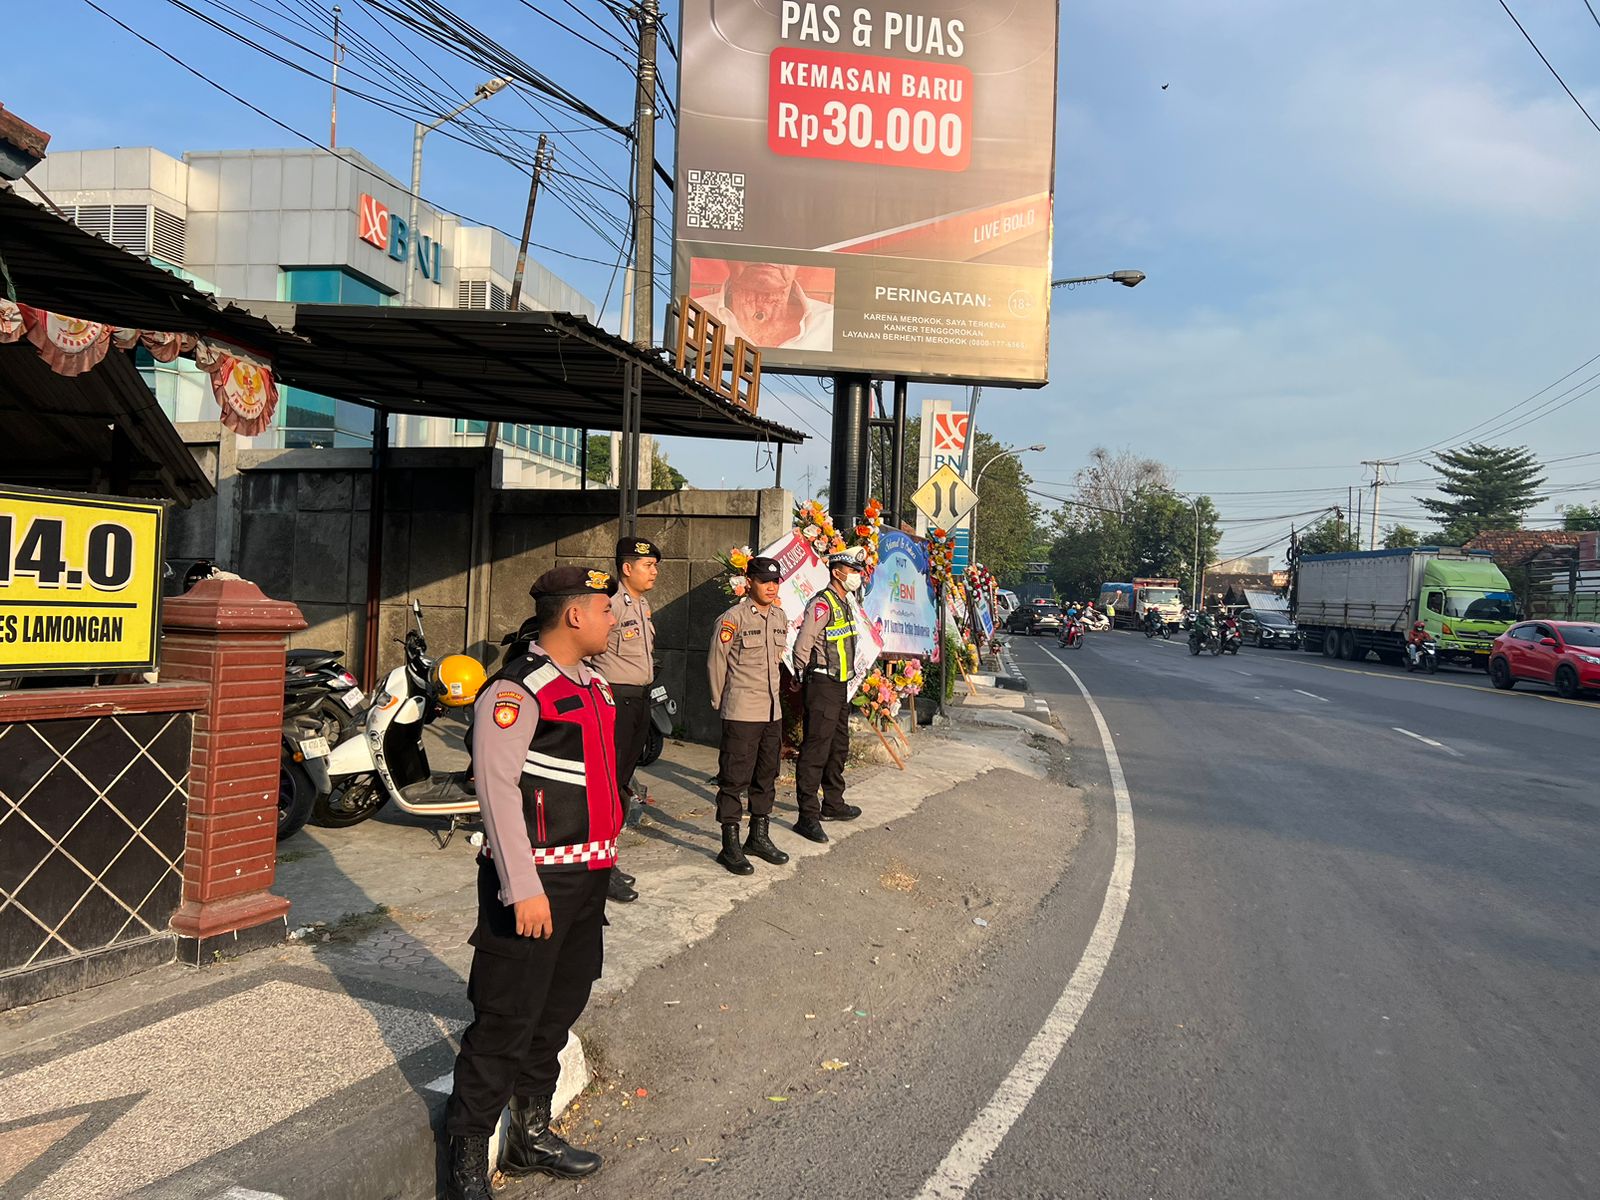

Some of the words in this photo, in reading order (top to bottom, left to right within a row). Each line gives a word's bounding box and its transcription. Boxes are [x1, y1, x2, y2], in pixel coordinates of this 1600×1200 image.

[781, 0, 841, 44] PAS
[852, 8, 873, 47] &
[884, 11, 965, 58] PUAS
[780, 61, 891, 95] KEMASAN
[901, 74, 963, 102] BARU
[778, 101, 962, 157] Rp30.000
[973, 220, 1001, 244] LIVE
[1003, 208, 1035, 233] BOLD
[388, 213, 442, 285] BNI
[875, 286, 992, 307] PERINGATAN:
[863, 313, 898, 322] KARENA
[945, 318, 967, 327] SAYA
[968, 319, 1006, 330] TERKENA
[883, 324, 919, 333] KANKER
[842, 330, 881, 340] LAYANAN
[882, 332, 924, 343] BERHENTI
[925, 336, 968, 346] MEROKOK
[935, 454, 968, 470] BN
[896, 556, 907, 568] HUT
[900, 581, 915, 601] BNI
[22, 615, 123, 643] LAMONGAN
